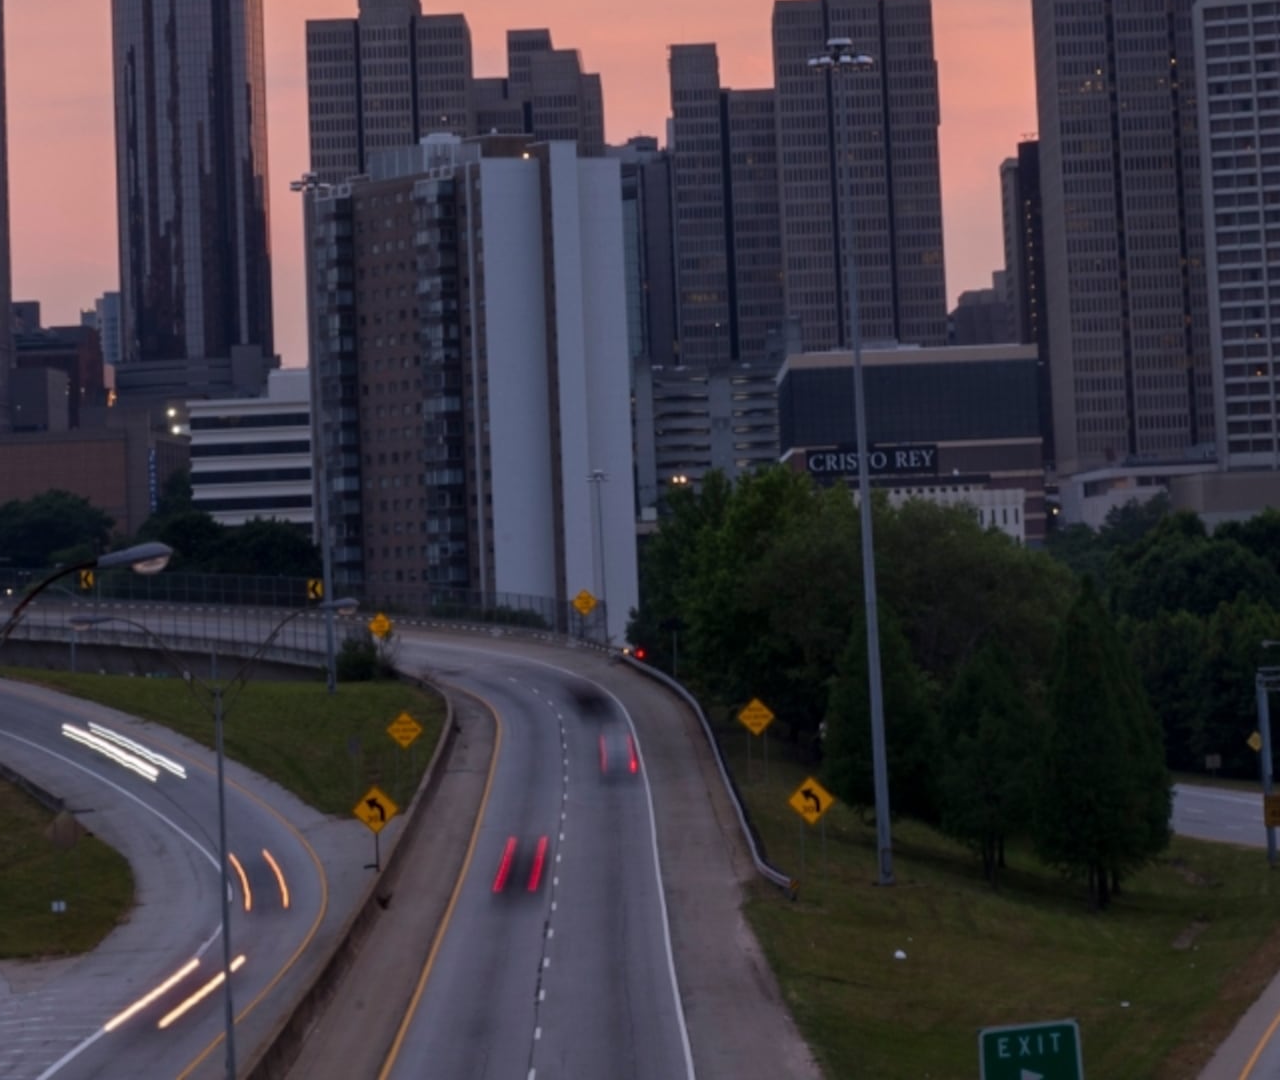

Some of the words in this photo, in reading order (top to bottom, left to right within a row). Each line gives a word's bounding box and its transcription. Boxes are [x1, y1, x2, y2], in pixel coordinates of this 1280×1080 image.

[808, 451, 887, 471] CRISO
[895, 449, 934, 468] REY
[996, 1032, 1062, 1059] EXIT
